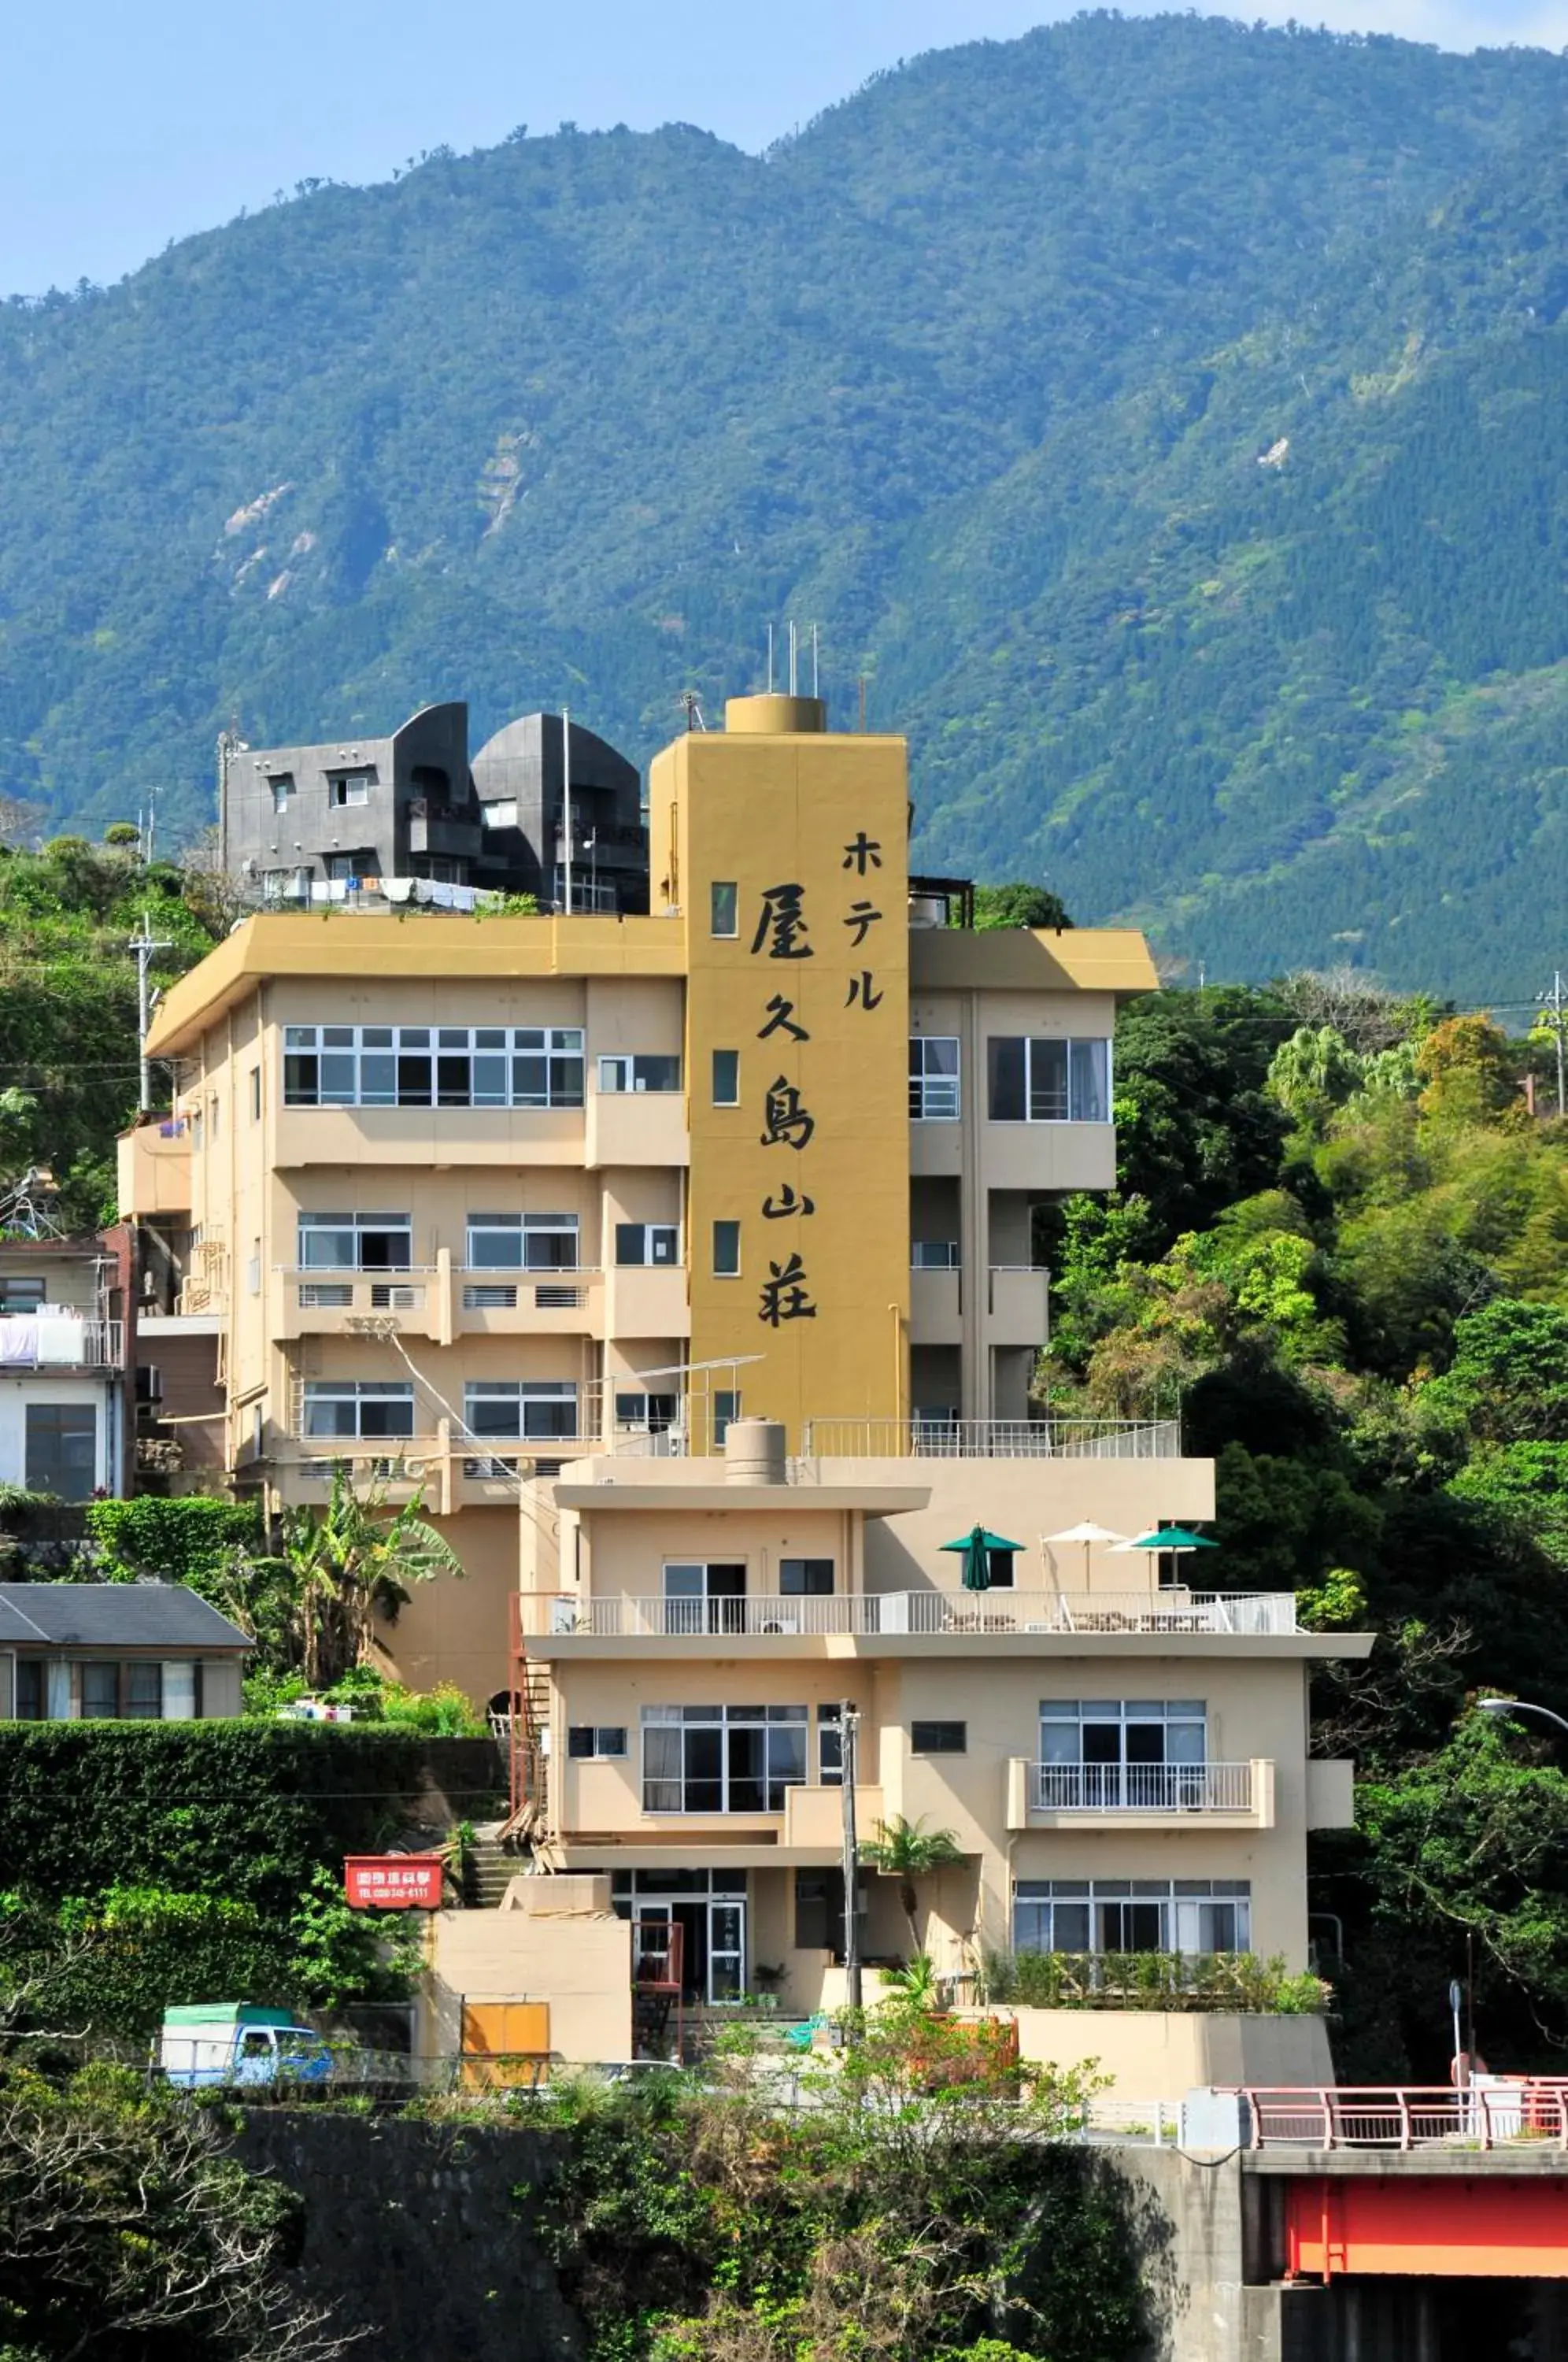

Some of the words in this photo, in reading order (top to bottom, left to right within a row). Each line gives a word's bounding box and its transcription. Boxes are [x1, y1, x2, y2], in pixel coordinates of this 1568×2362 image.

[842, 832, 883, 1011] ホテル
[750, 883, 816, 1328] 屋久島山荘
